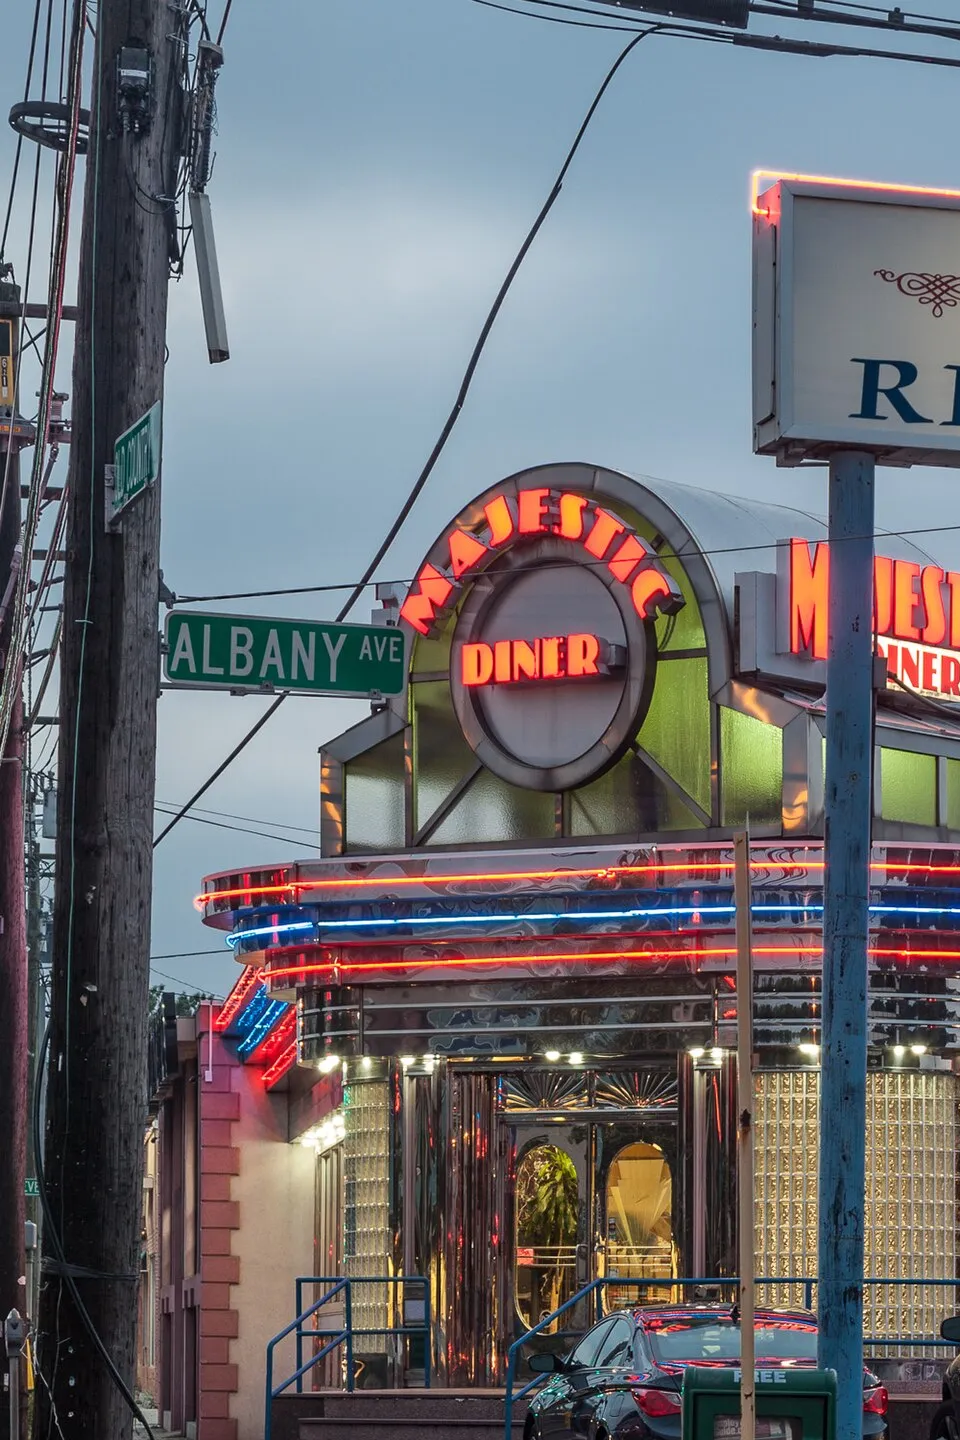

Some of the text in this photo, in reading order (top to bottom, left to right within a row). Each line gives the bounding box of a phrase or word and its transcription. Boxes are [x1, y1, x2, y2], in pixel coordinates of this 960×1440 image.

[399, 488, 671, 637] MAJESTIC
[170, 622, 403, 683] ALBANY AVE
[461, 633, 600, 687] DINER
